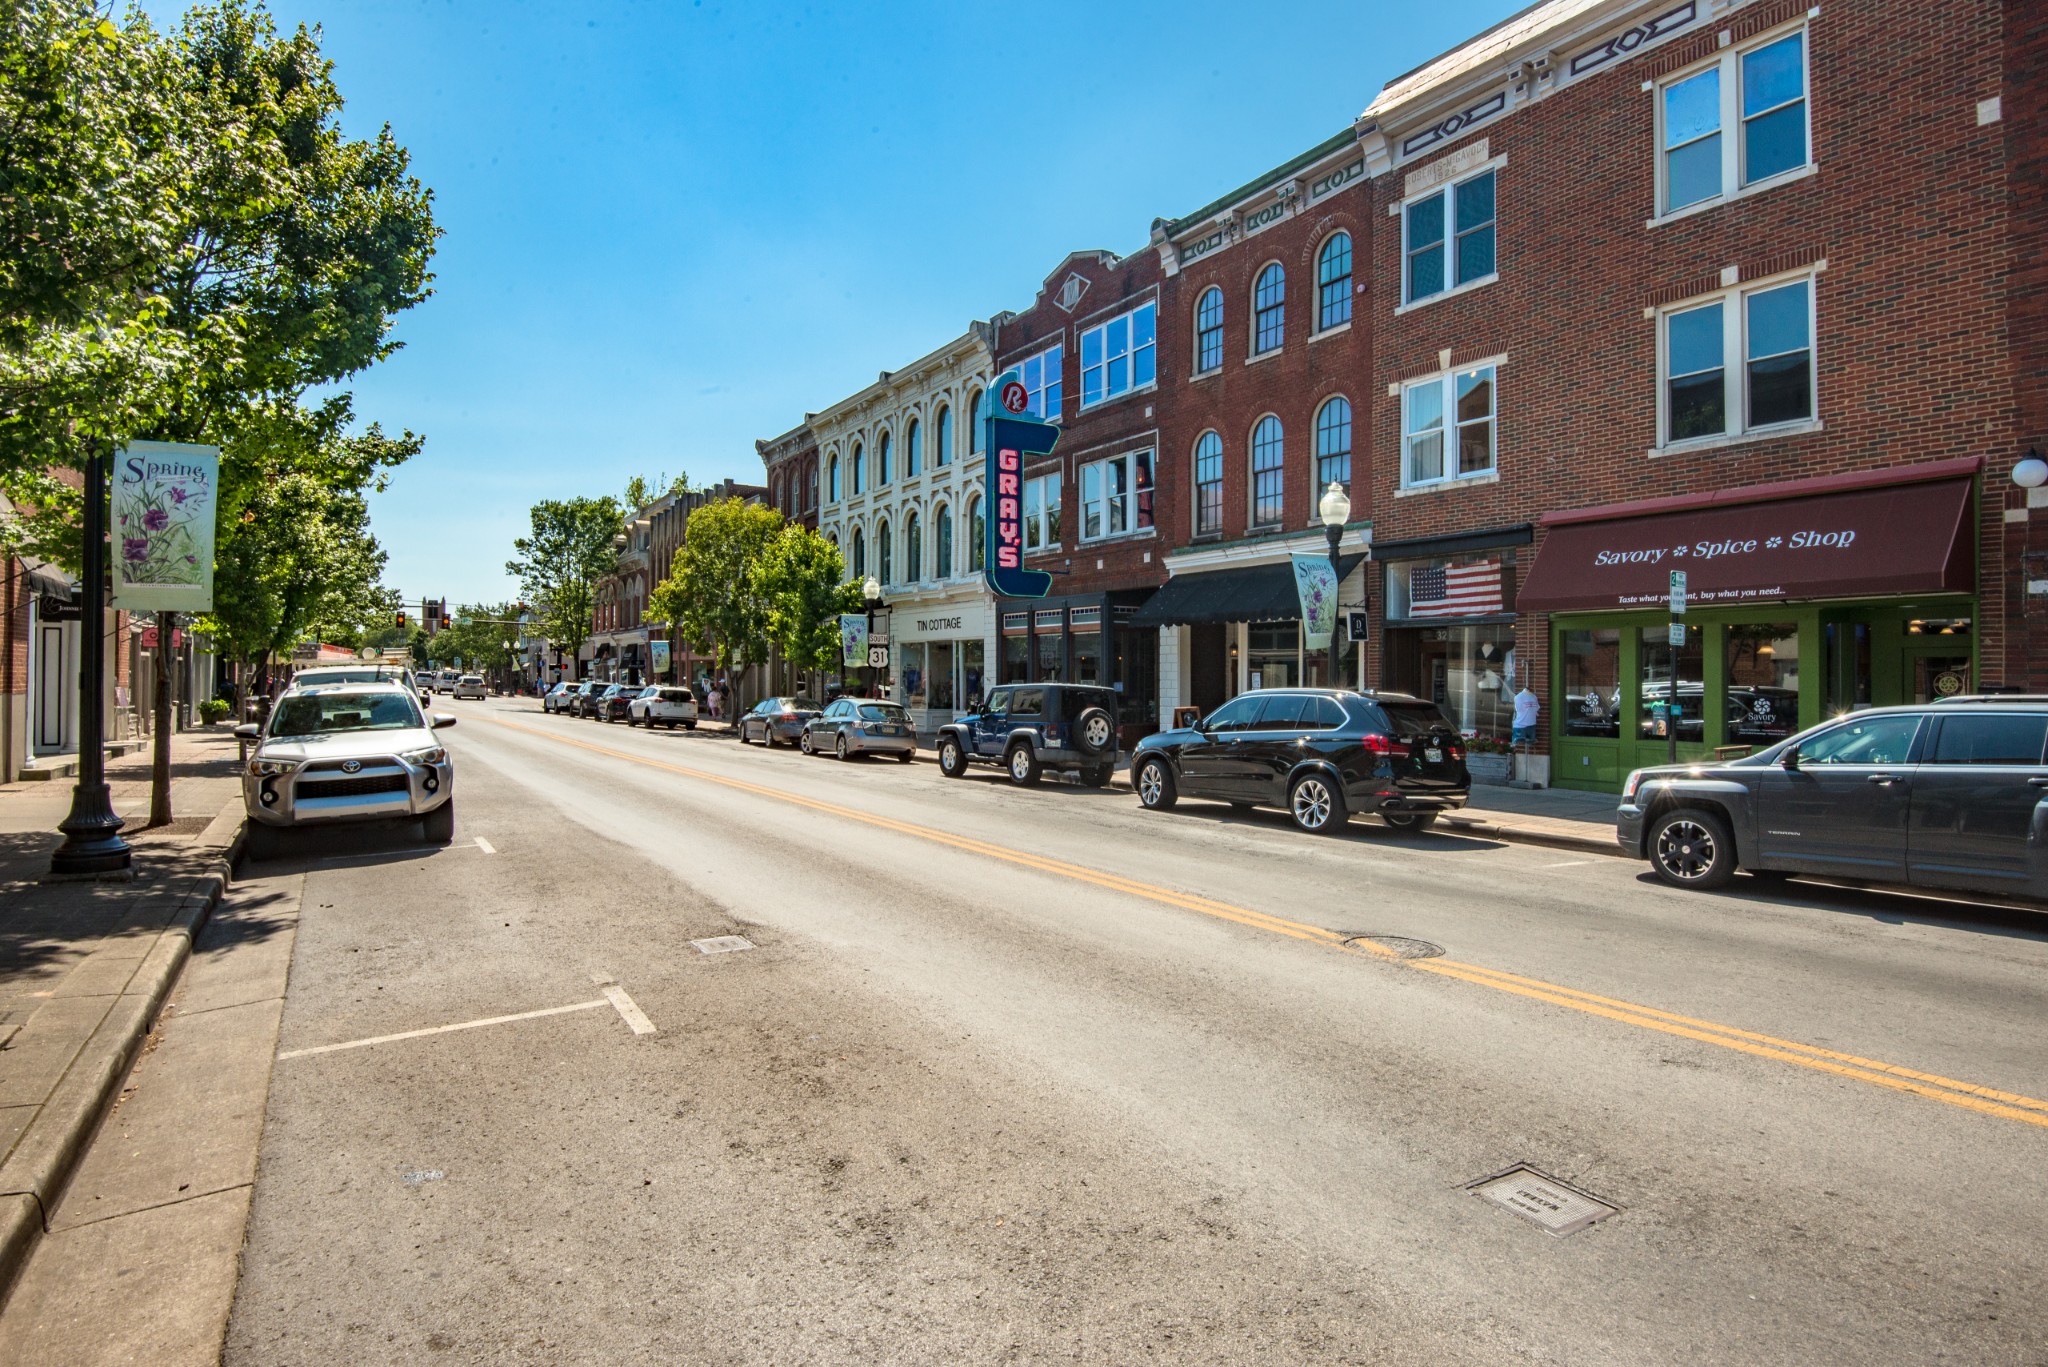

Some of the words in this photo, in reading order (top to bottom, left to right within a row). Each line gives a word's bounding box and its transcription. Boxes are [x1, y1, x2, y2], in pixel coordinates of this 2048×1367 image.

[1434, 166, 1457, 182] 1926
[125, 456, 207, 484] Spring
[998, 448, 1020, 568] GRAY'S
[1594, 548, 1668, 566] Savory
[1692, 539, 1757, 559] Spice
[1788, 530, 1856, 549] Shop
[1298, 561, 1331, 578] Spring
[1618, 596, 1638, 604] Taste
[1639, 595, 1658, 603] what
[1659, 595, 1671, 605] yo
[1700, 591, 1716, 601] buy
[1717, 589, 1738, 598] what
[1740, 589, 1757, 599] you
[917, 620, 928, 632] TIN
[929, 616, 962, 631] COTTAGE
[869, 634, 888, 643] SOUTH
[872, 651, 884, 663] 31
[1580, 705, 1603, 714] Savory
[1748, 712, 1776, 722] Savory
